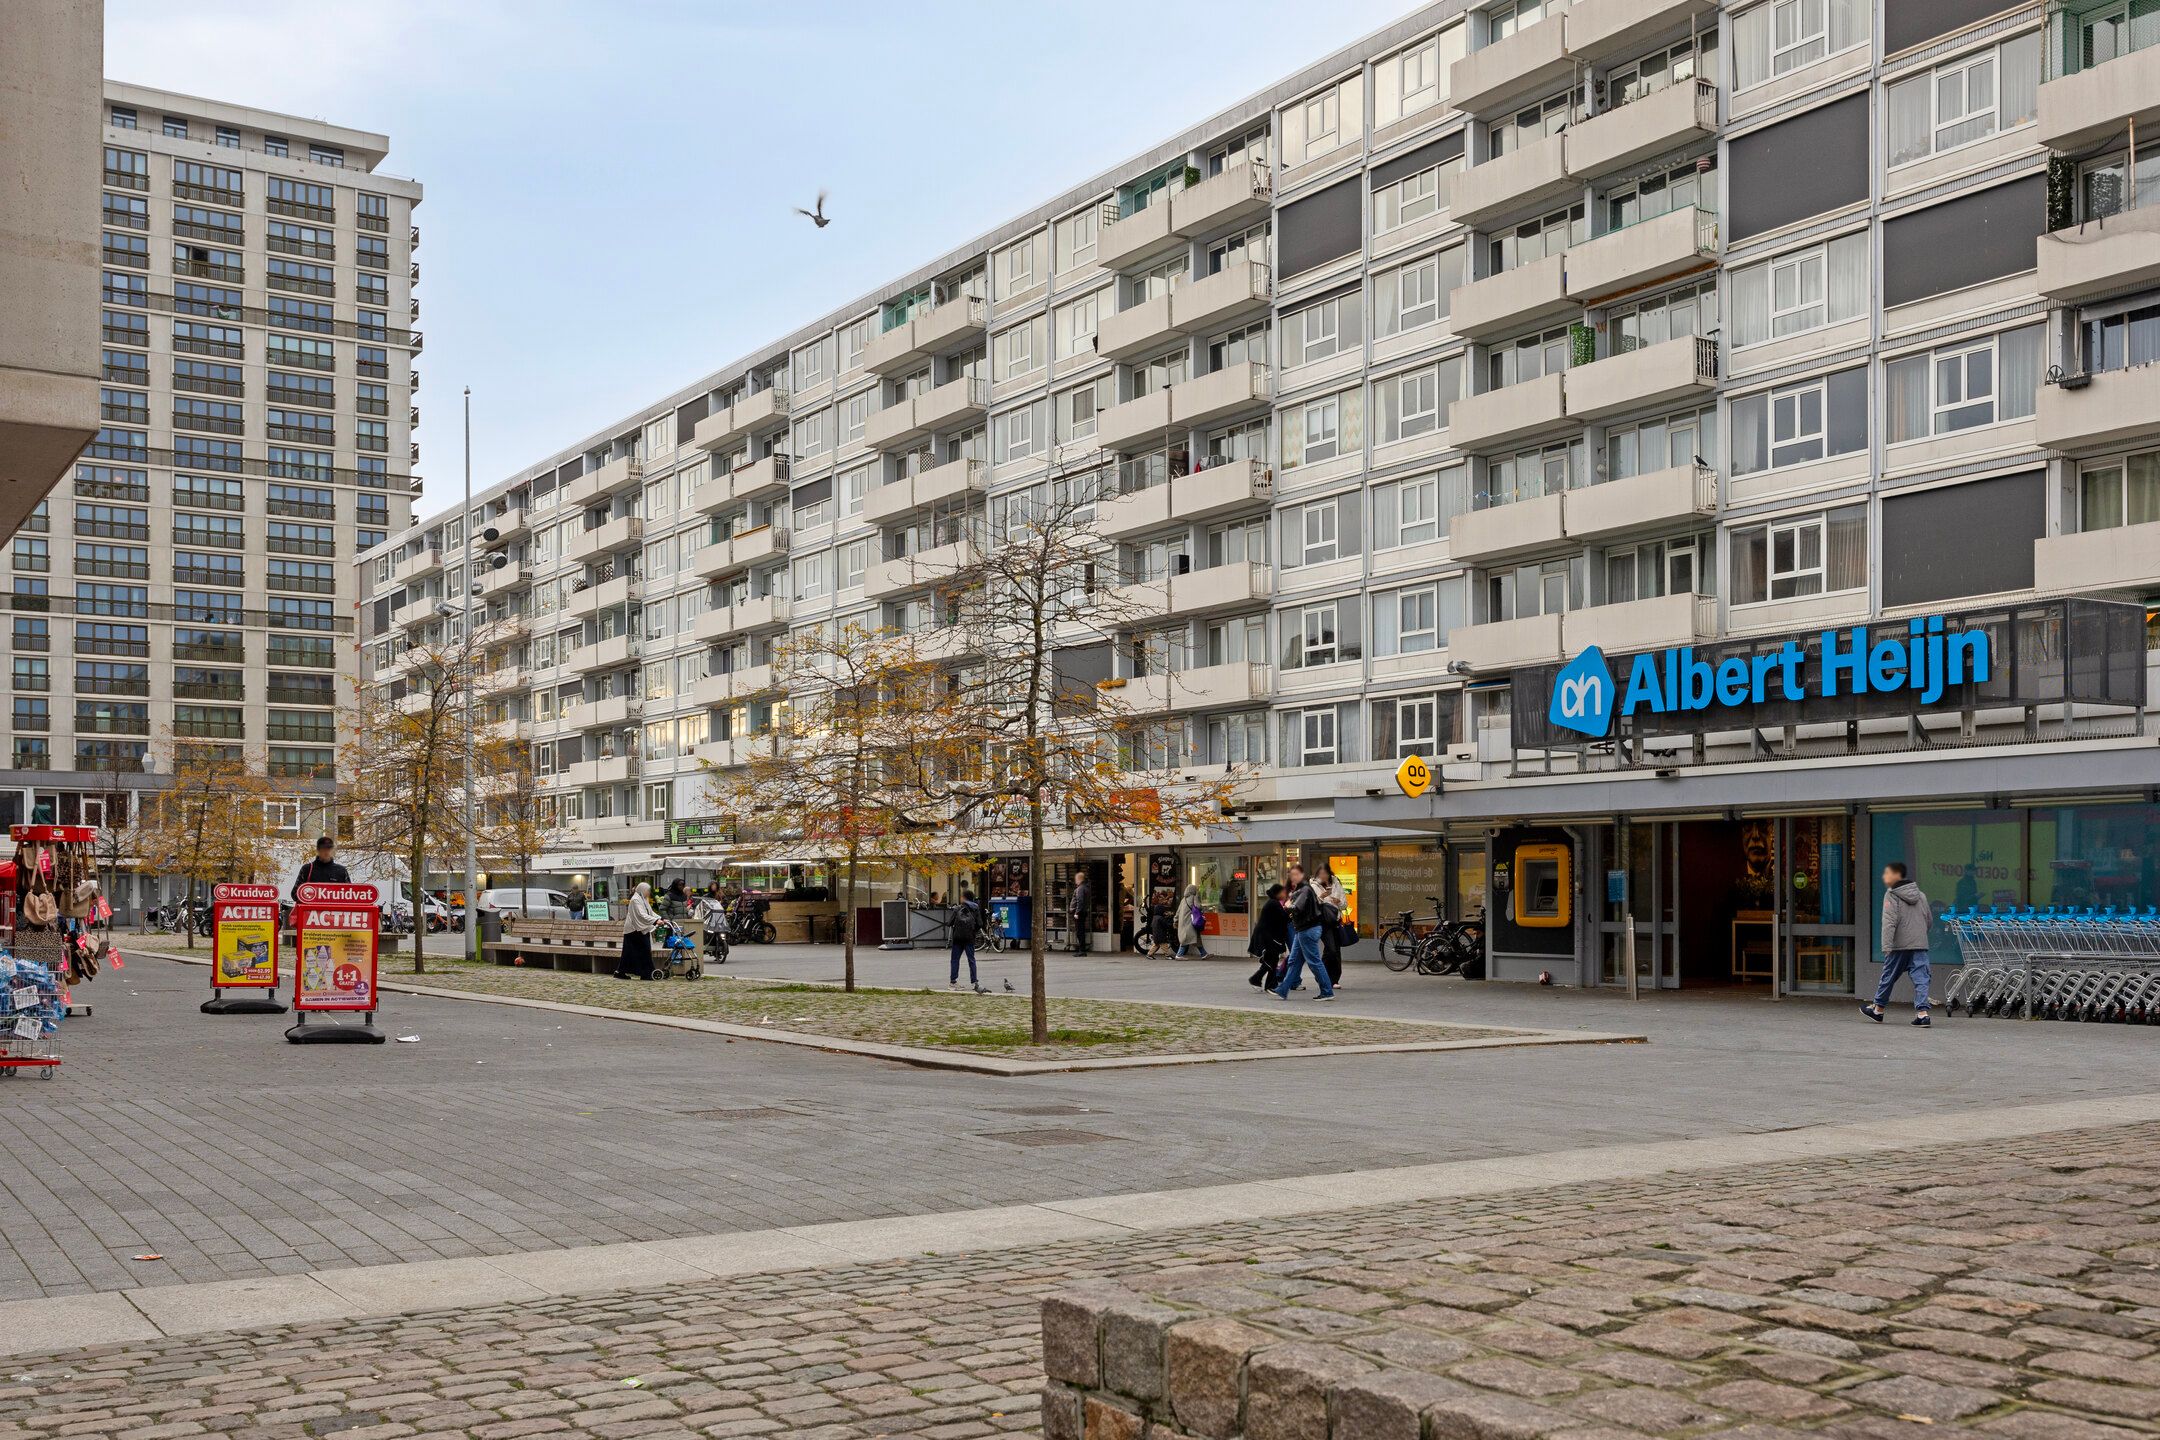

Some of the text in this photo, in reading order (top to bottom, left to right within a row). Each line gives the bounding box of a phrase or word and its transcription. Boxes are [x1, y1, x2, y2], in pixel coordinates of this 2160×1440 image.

[1621, 615, 1990, 716] Albert Heijn
[231, 888, 274, 898] Kruidvat
[318, 887, 373, 900] Kruidvat
[222, 906, 271, 919] ACTIE!
[306, 910, 368, 928] ACTIE!
[336, 969, 358, 982] 1+1
